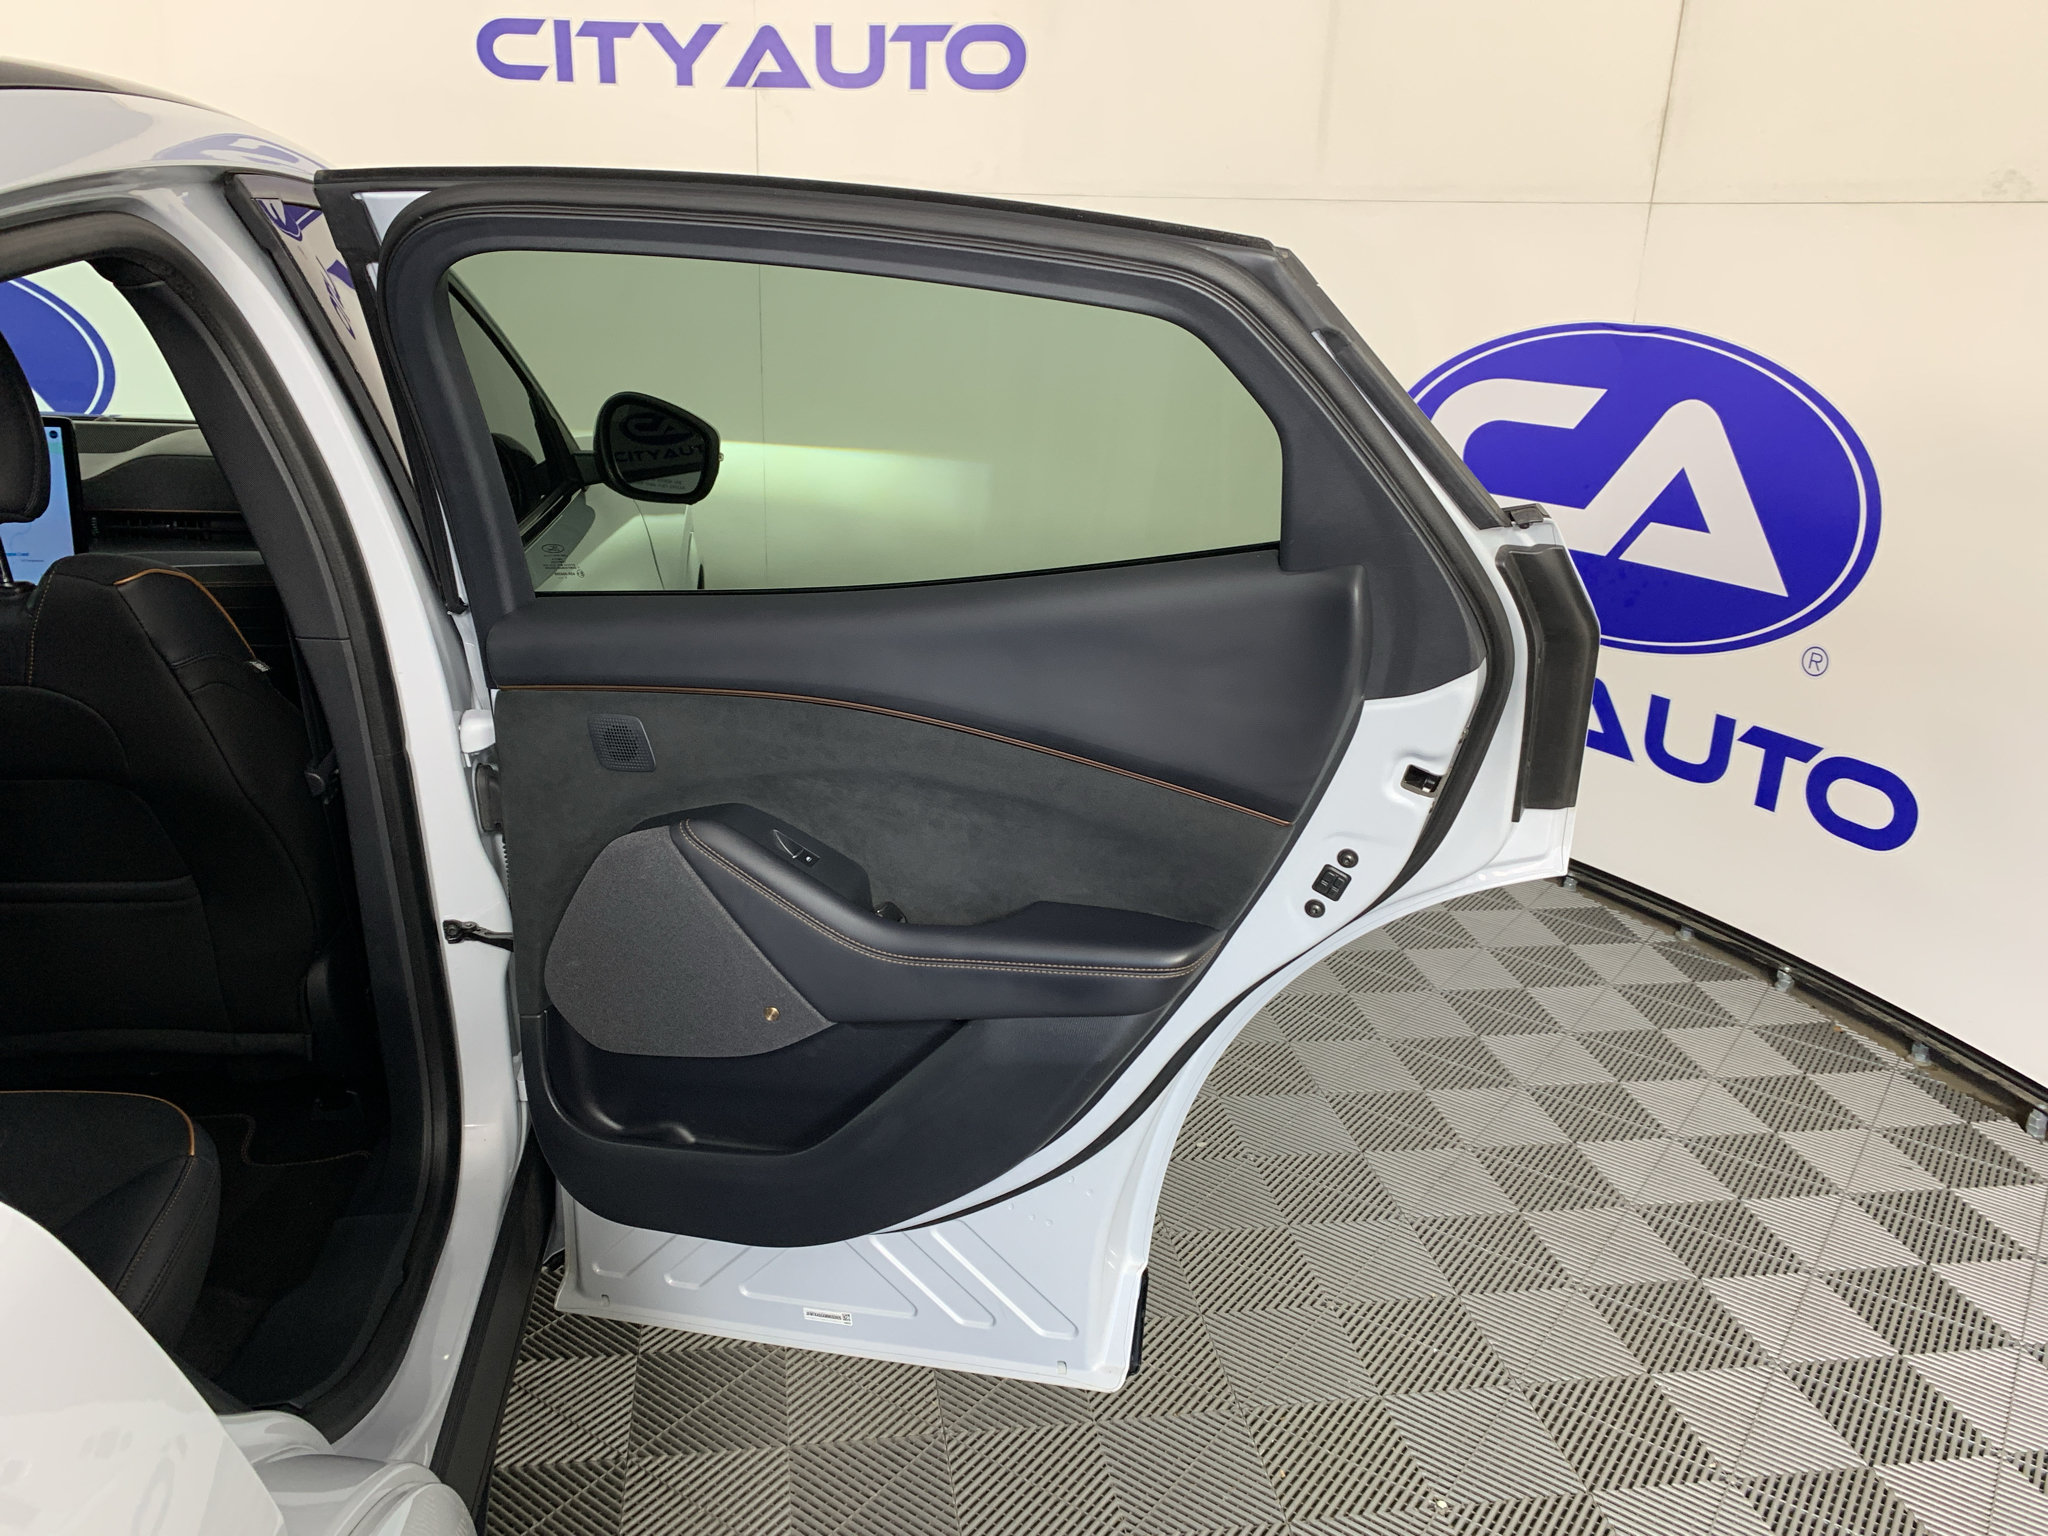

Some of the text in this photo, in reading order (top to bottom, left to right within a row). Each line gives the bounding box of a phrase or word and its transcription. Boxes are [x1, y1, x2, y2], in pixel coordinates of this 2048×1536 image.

[476, 17, 1027, 91] CITY AUTO
[663, 444, 704, 460] AUT
[1430, 377, 1789, 598] CA
[1586, 677, 1919, 852] AUTO
